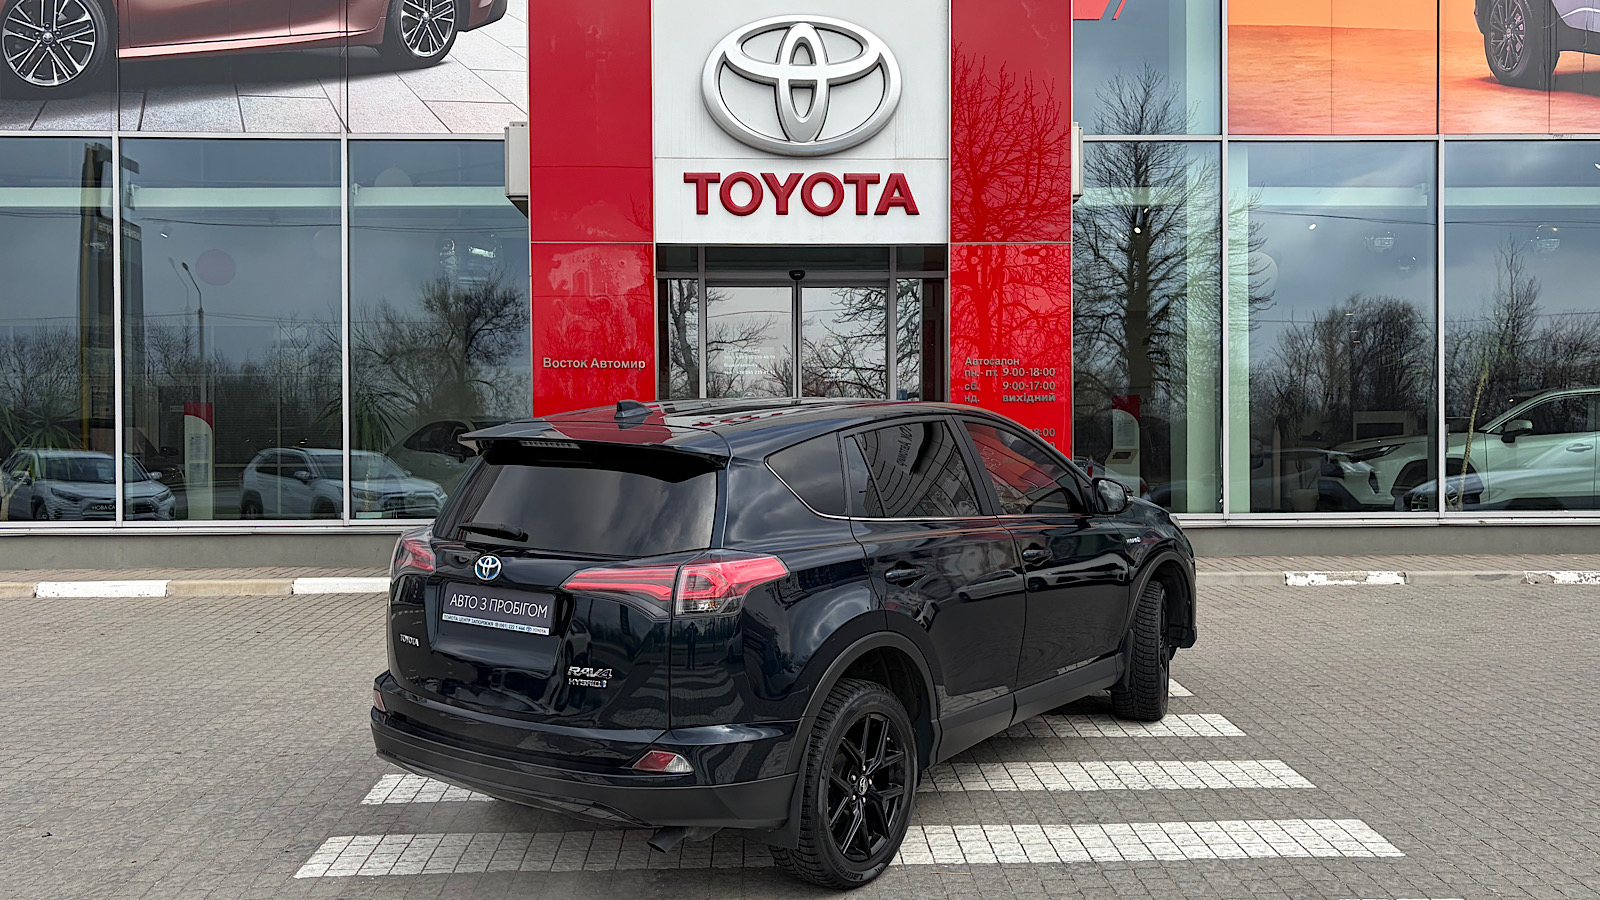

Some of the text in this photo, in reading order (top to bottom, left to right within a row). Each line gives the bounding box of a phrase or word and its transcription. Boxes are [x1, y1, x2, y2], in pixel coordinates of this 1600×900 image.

[684, 172, 920, 216] TOYOTA
[543, 357, 646, 371] Восток Автомир
[964, 357, 1020, 366] Автосалон
[1002, 381, 1056, 391] 9:00-17:00
[964, 392, 1056, 403] нд. вихідний
[449, 593, 549, 619] АВТО З ПРОБІГОМ
[399, 633, 420, 647] TOYOTA
[567, 666, 613, 679] RAV4
